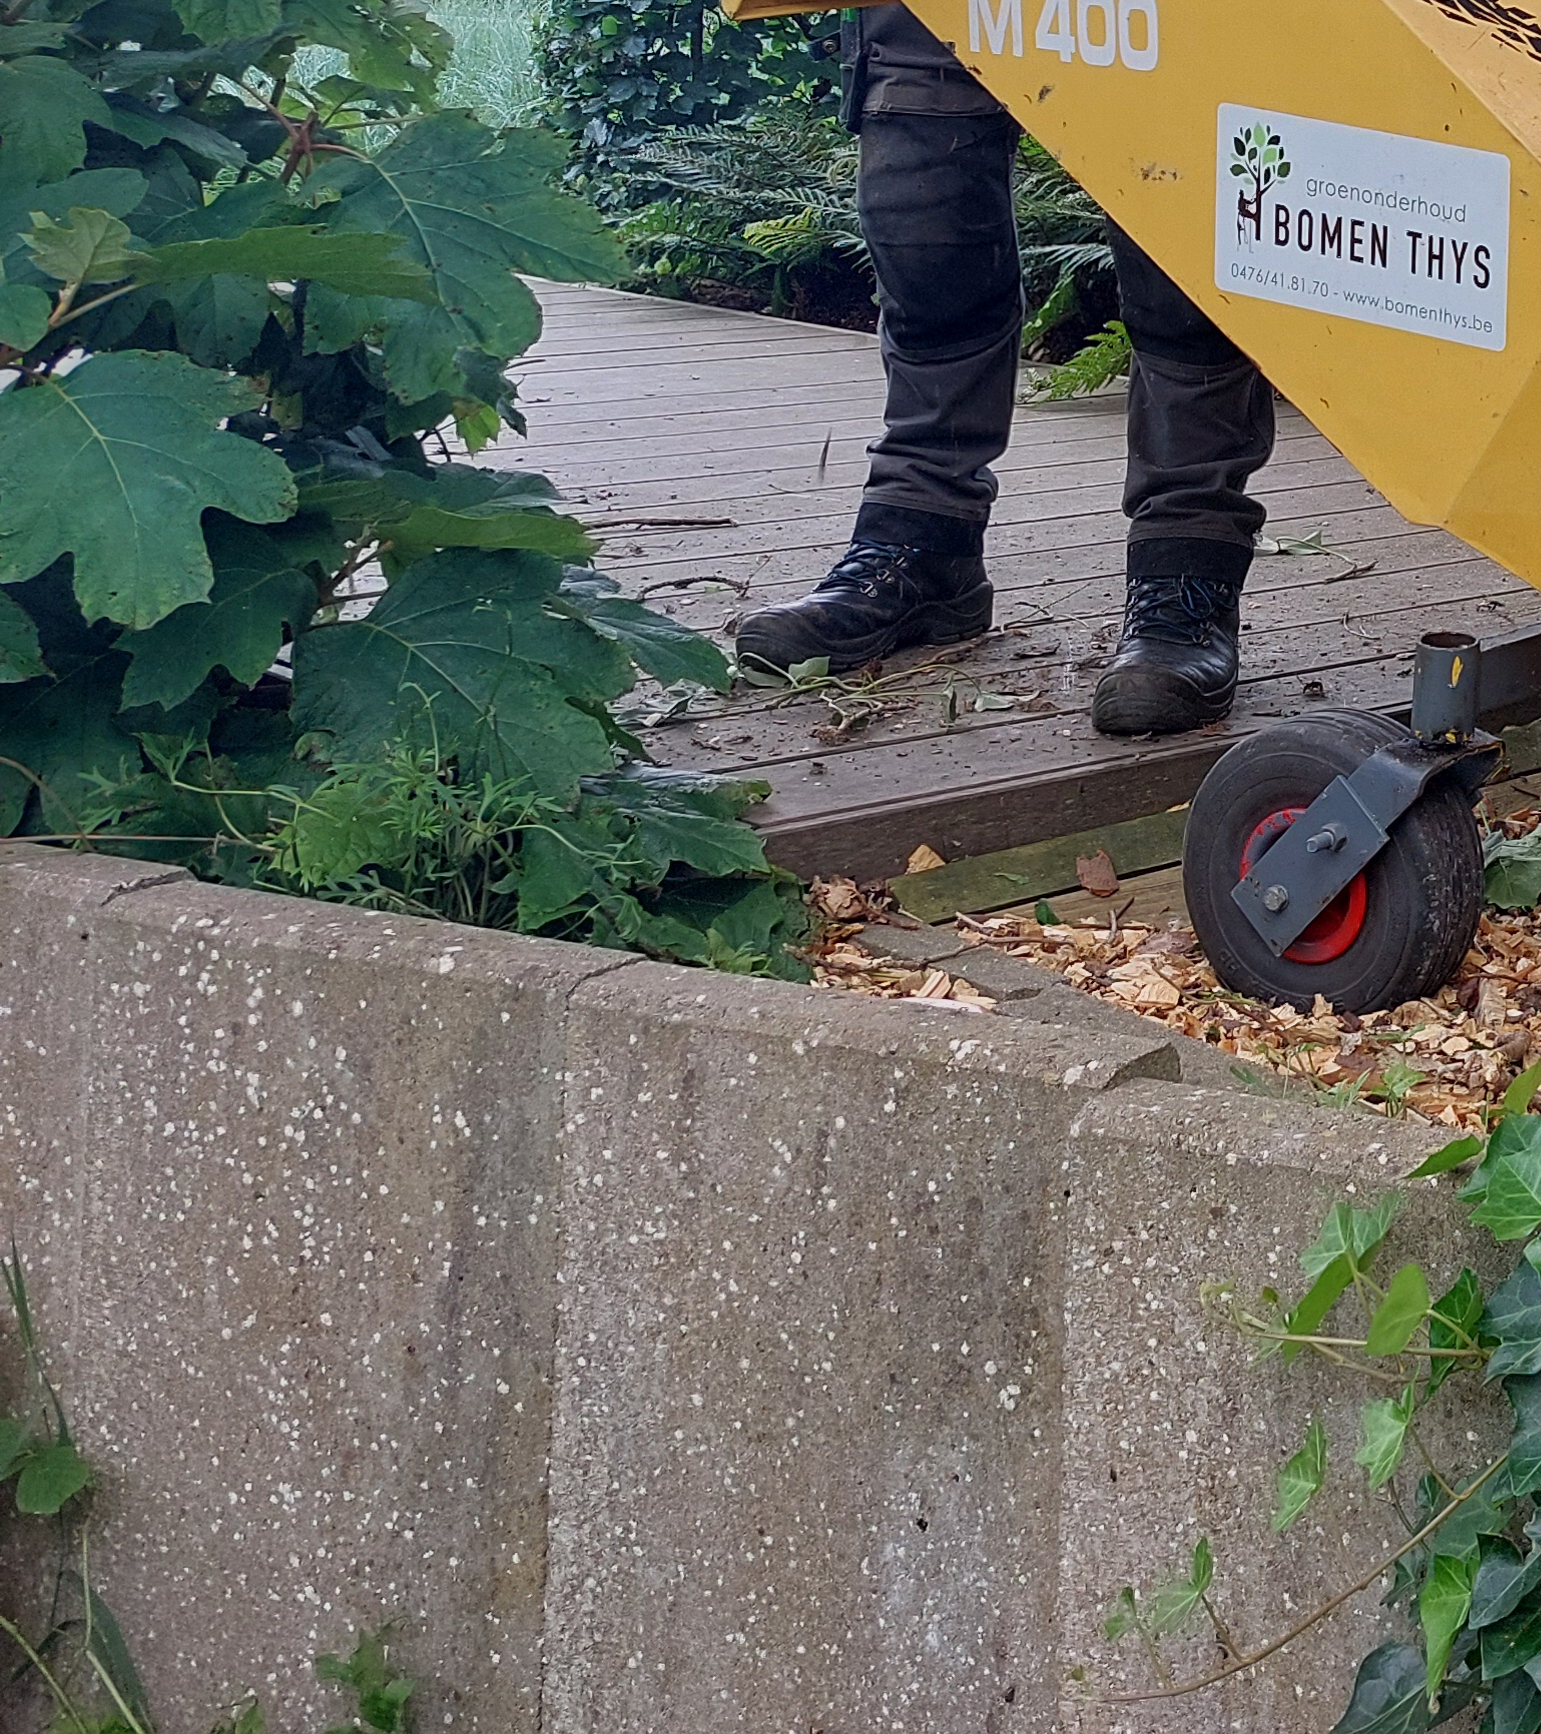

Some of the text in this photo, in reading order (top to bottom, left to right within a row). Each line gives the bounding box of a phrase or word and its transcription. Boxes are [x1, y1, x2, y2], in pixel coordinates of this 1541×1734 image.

[1306, 177, 1466, 223] groenonderhoud
[1274, 203, 1491, 290] BOMEN THYS
[1231, 262, 1329, 298] 0476/41.81.70
[1343, 289, 1493, 334] www.bomenthys.be
